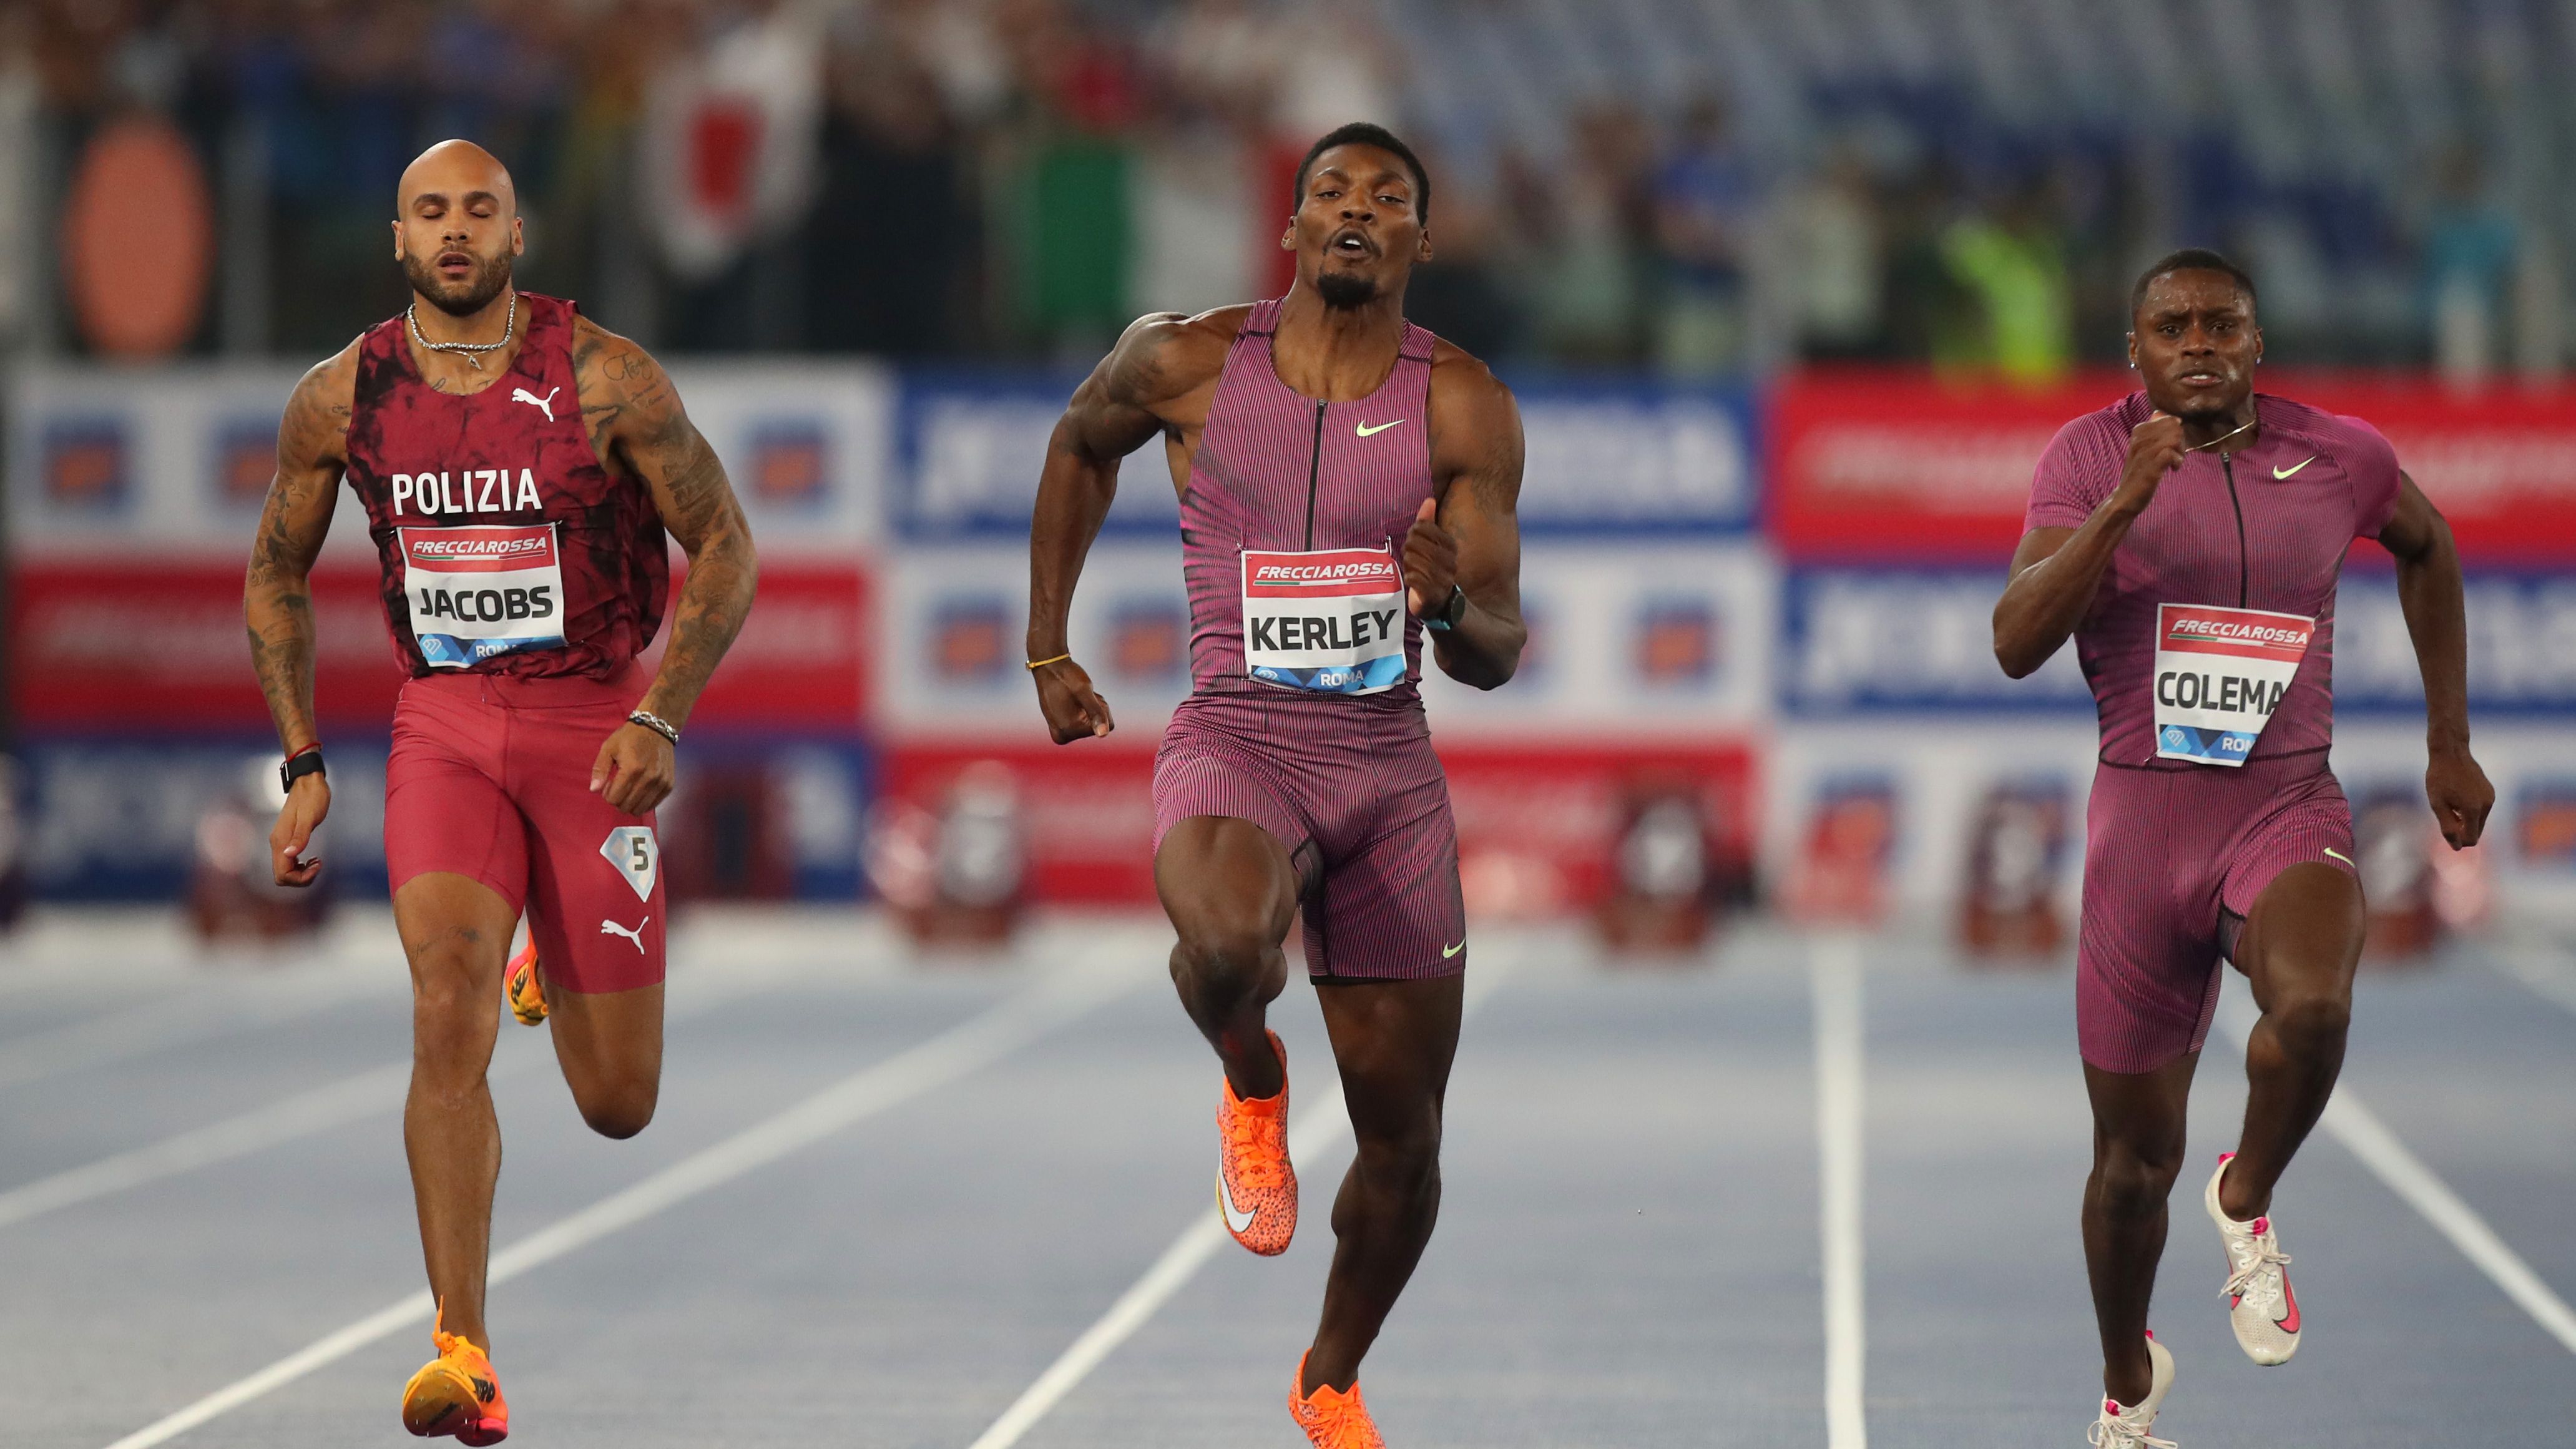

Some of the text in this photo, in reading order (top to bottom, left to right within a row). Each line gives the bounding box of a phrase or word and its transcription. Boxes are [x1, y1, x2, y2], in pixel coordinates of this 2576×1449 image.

[392, 468, 542, 516] POLIZIA
[413, 537, 547, 554] FRECCIAROSSA
[1256, 563, 1394, 579] FRECCIAROSSA
[420, 586, 553, 622] JACOBS
[1250, 609, 1398, 651] KERLEY
[2172, 619, 2308, 645] FRECCIAROSSA
[1320, 670, 1364, 686] ROMA
[632, 837, 649, 871] 5
